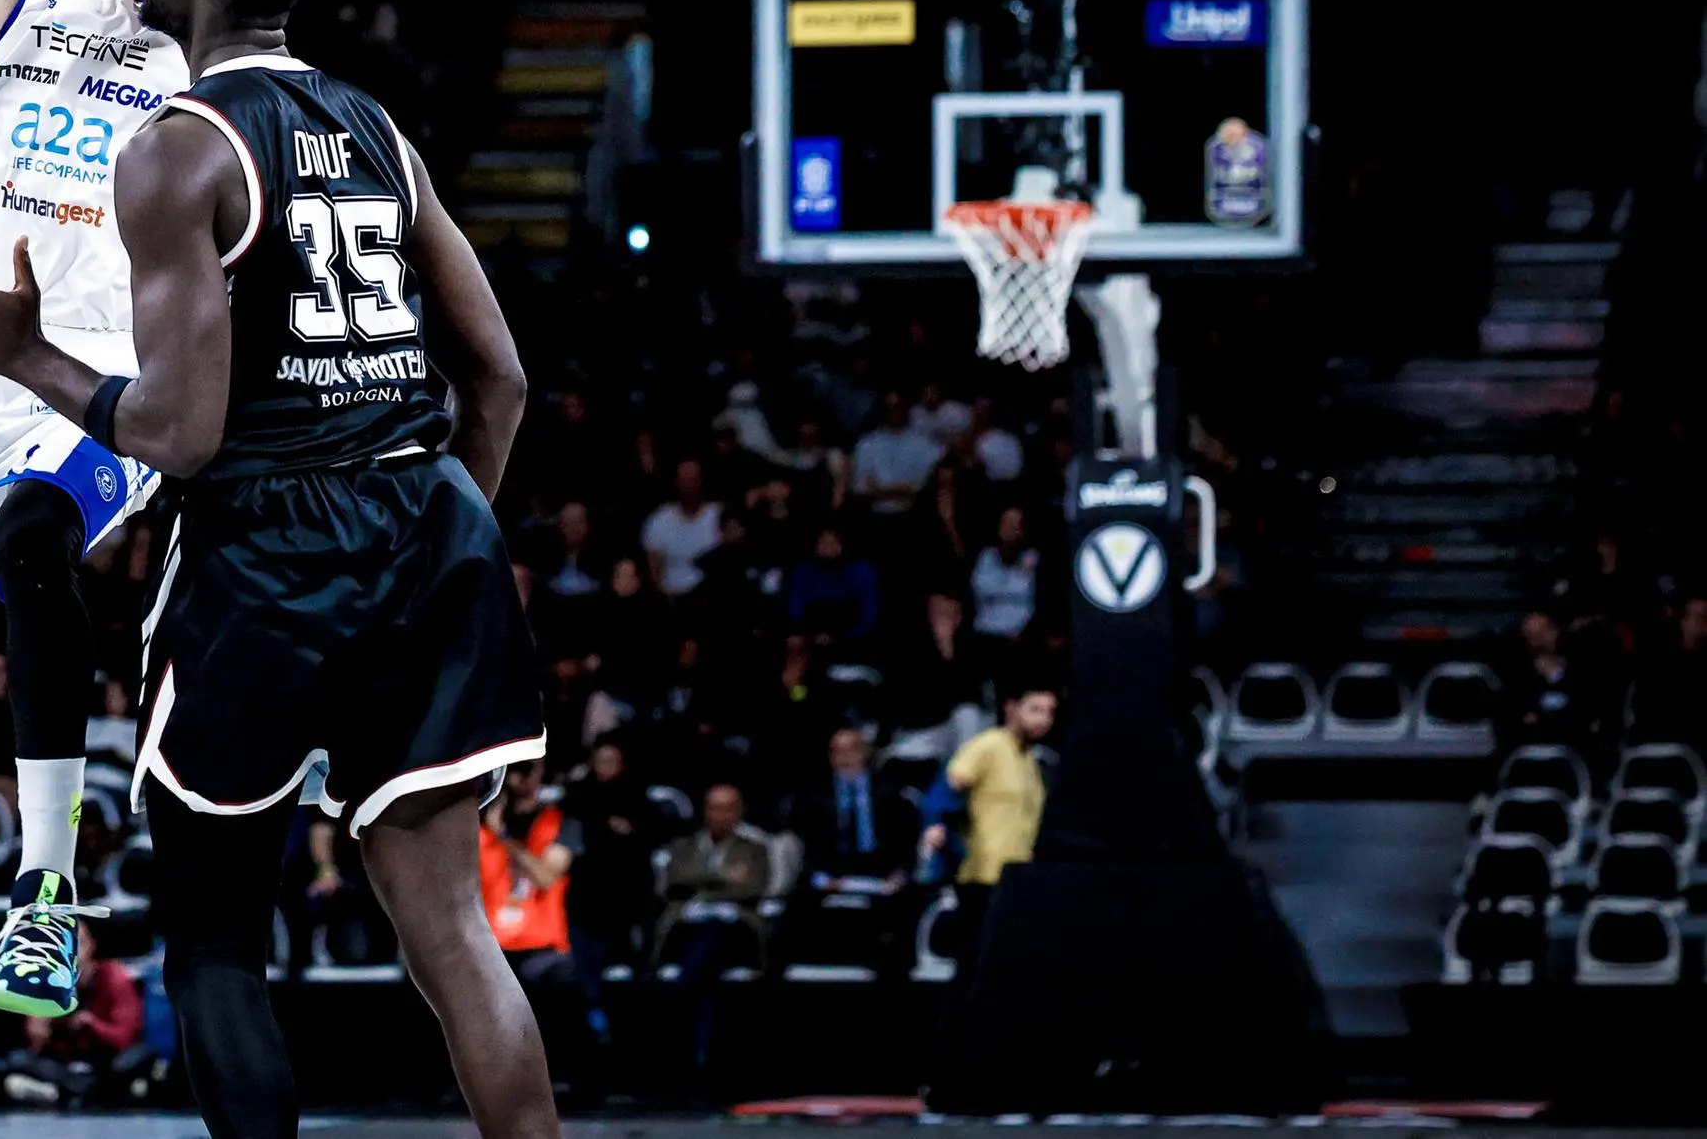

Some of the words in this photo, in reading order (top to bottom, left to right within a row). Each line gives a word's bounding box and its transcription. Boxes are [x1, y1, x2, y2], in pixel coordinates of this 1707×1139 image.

[11, 102, 113, 166] a2a
[13, 156, 33, 170] IFE
[34, 160, 107, 184] COMPANY
[1, 180, 105, 228] Humangest
[286, 193, 419, 342] 35
[276, 355, 347, 386] SAVOA
[321, 387, 403, 408] BOLOGNA
